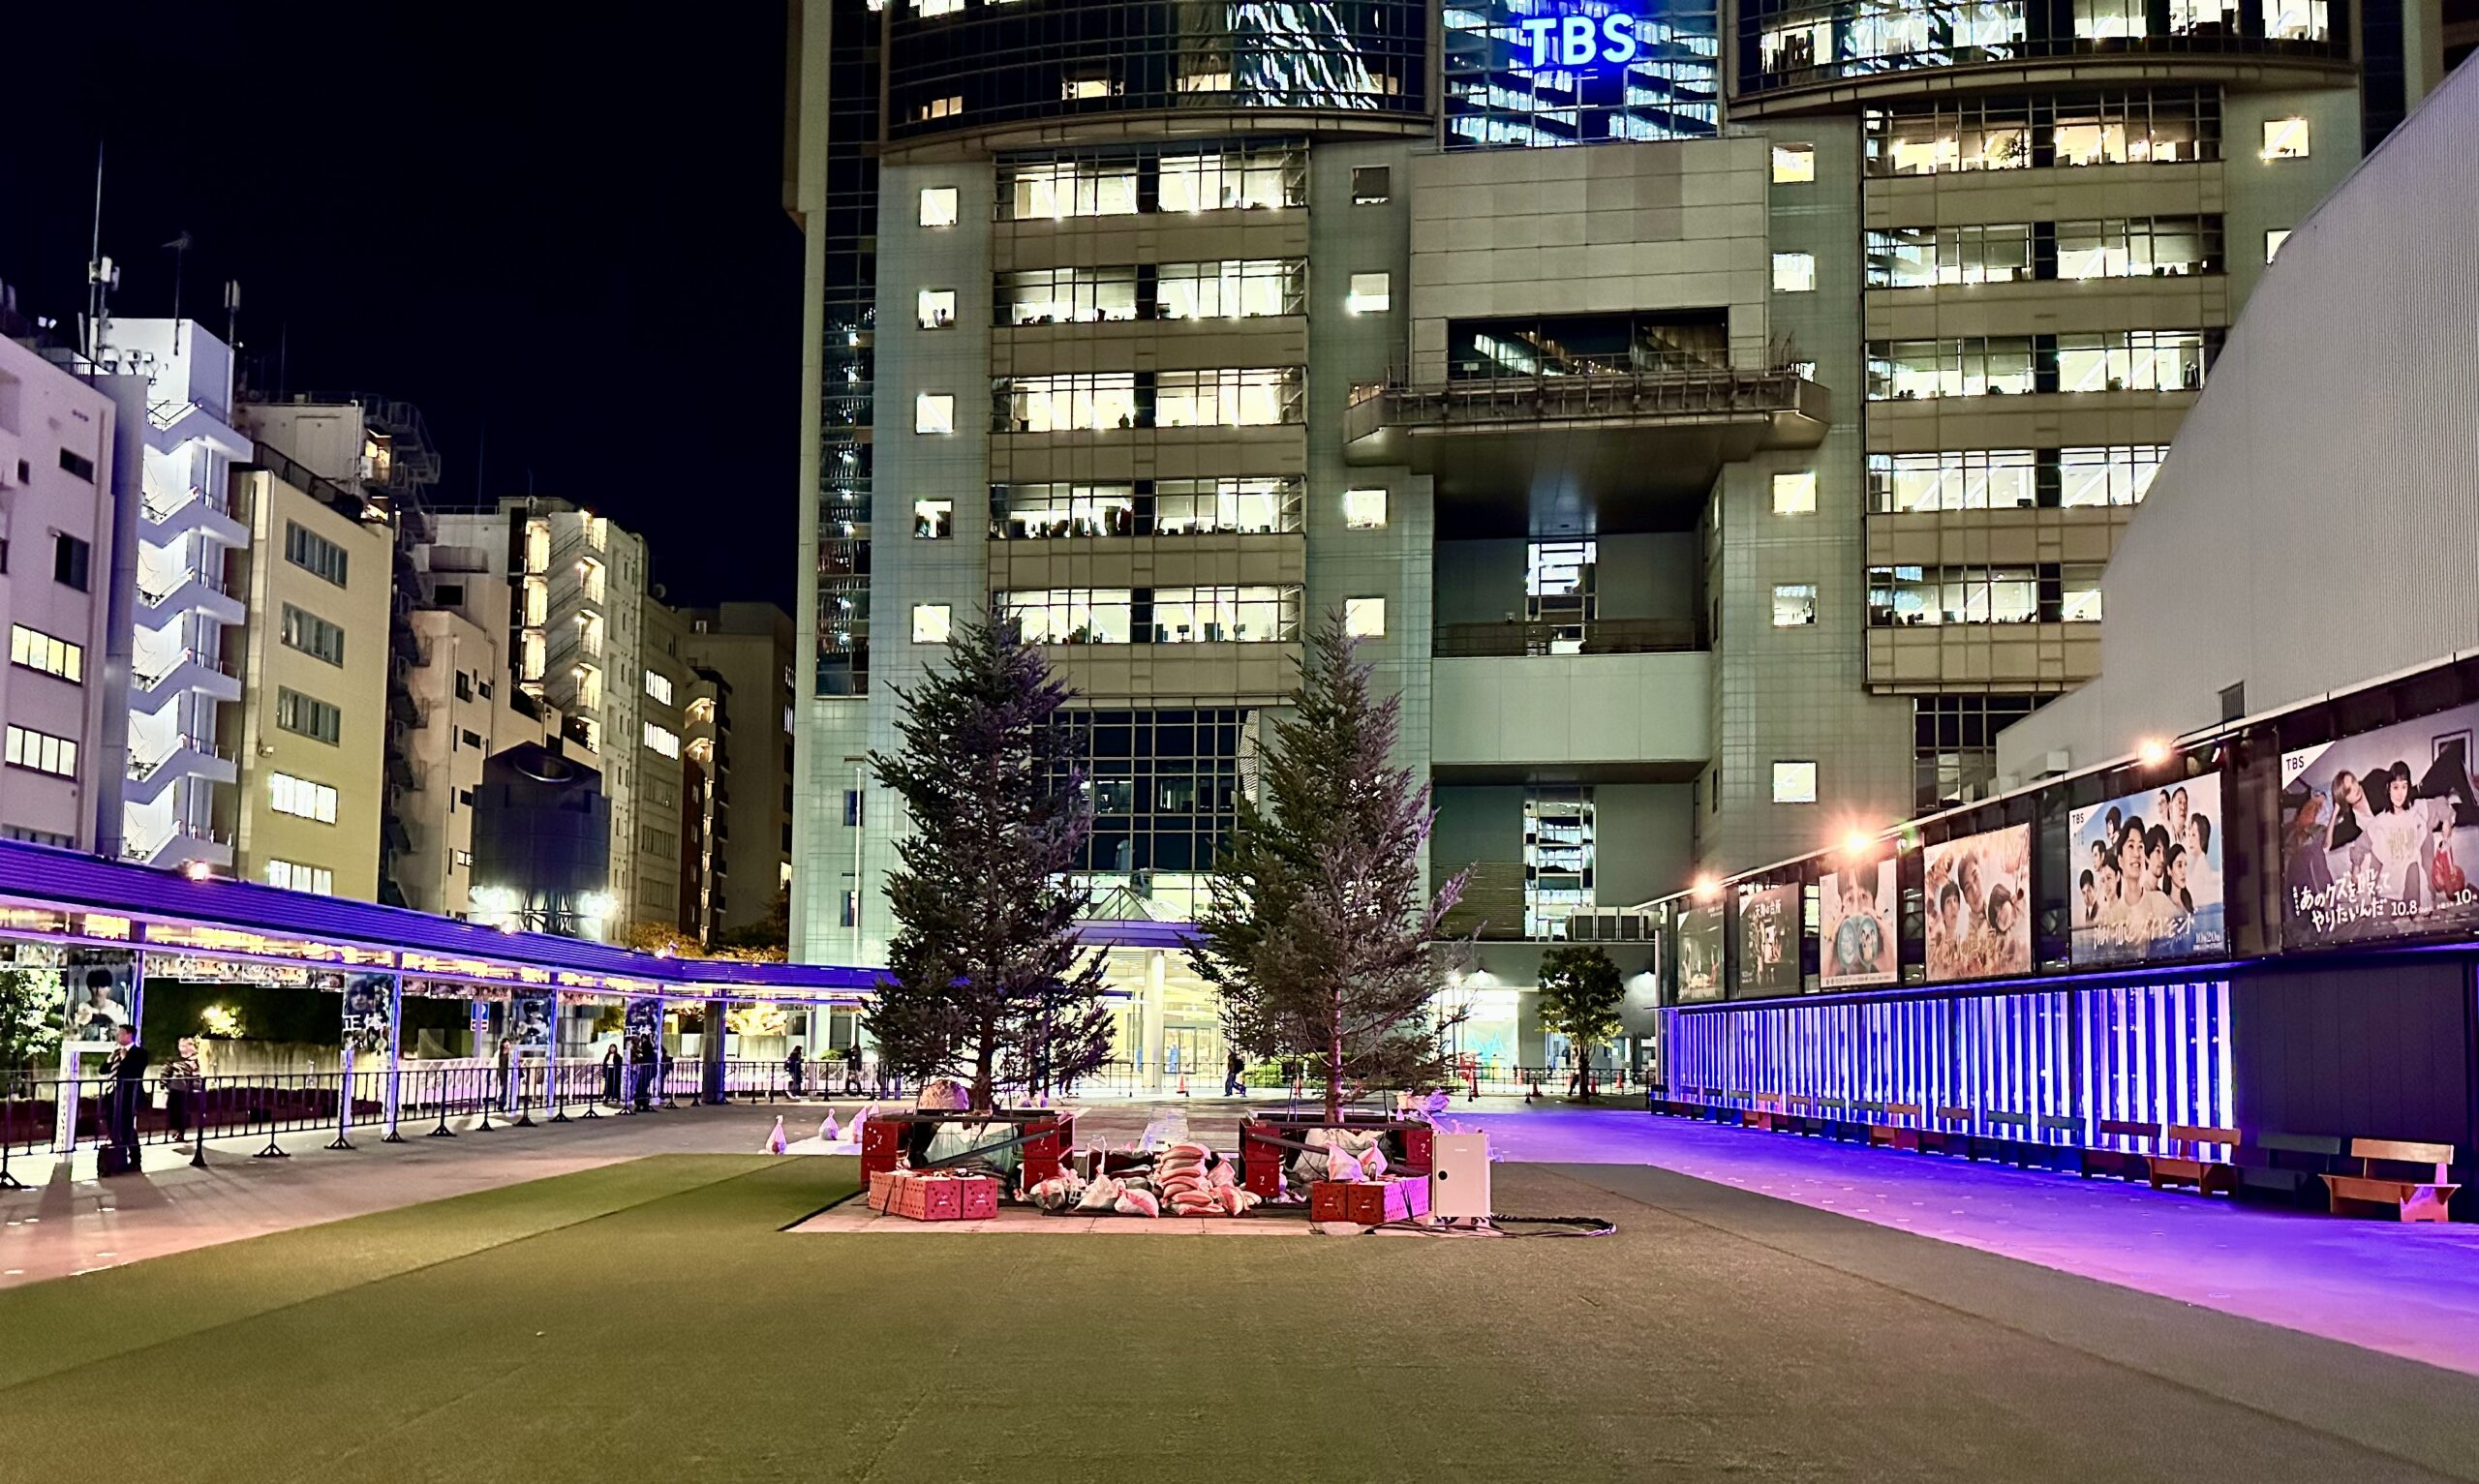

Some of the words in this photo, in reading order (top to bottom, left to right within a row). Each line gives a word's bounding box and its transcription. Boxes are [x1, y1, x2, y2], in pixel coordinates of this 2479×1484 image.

[1521, 13, 1637, 68] TBS
[2285, 755, 2305, 772] TBS
[2071, 812, 2085, 825] TBS
[2300, 868, 2391, 911] あのクズを殴って
[2311, 896, 2388, 933] やりたいんだ
[2391, 899, 2418, 917] 10.8
[342, 1012, 383, 1032] 正体
[624, 1024, 653, 1038] 正体
